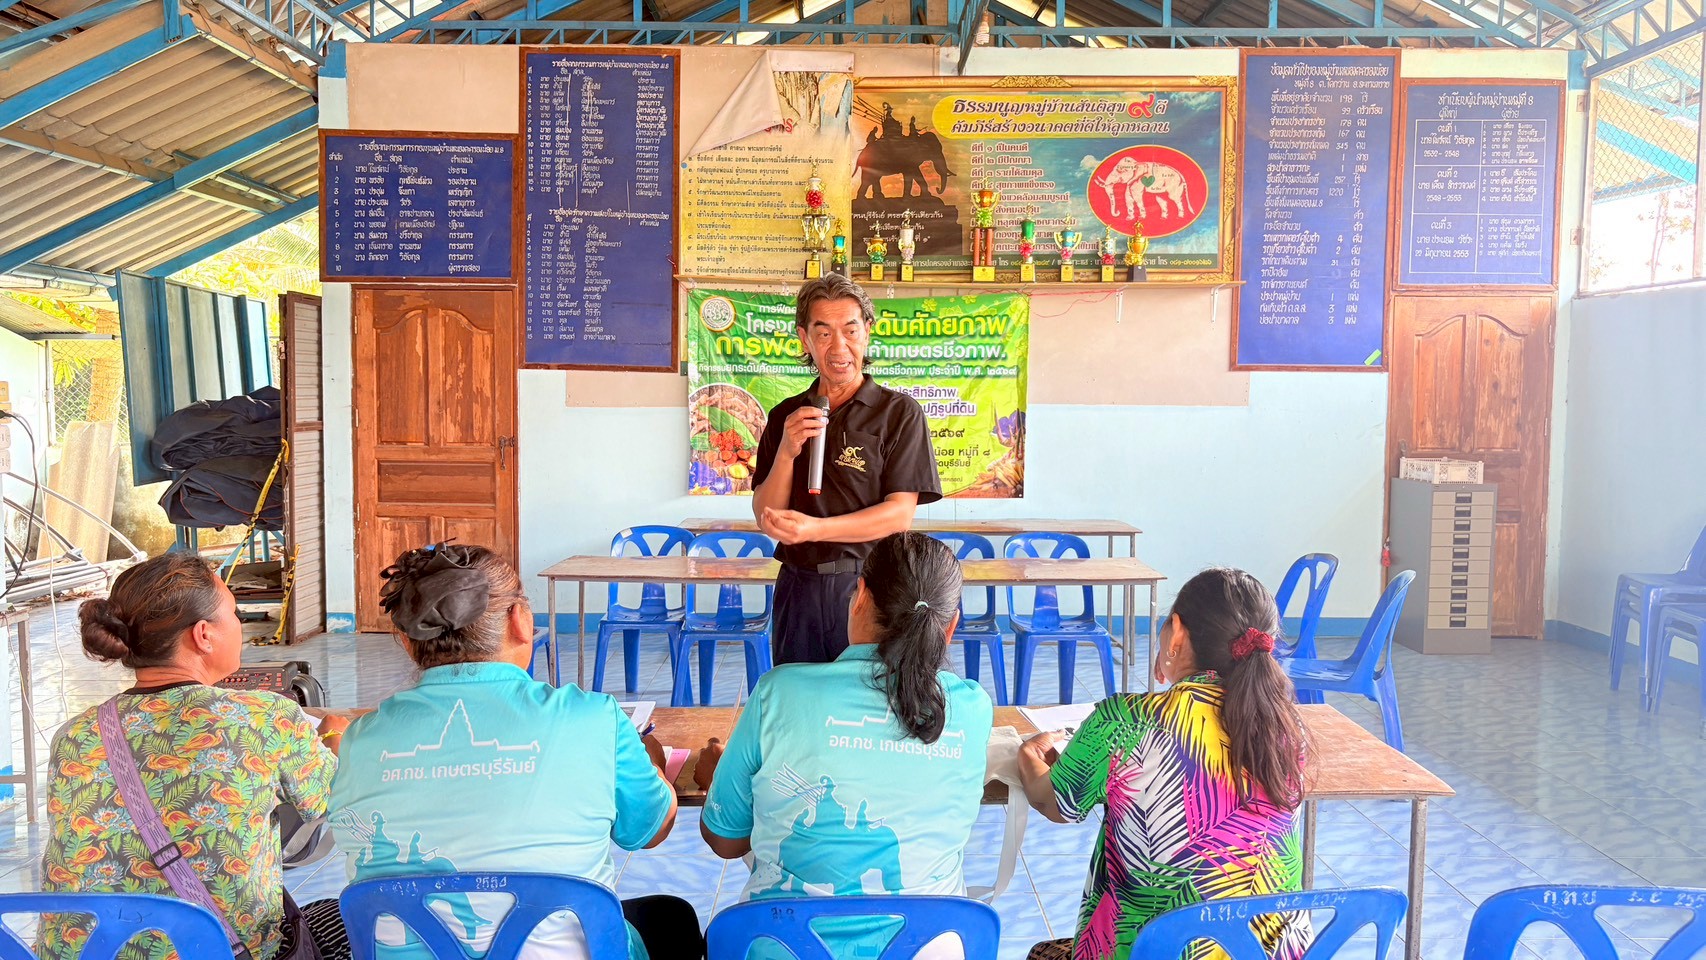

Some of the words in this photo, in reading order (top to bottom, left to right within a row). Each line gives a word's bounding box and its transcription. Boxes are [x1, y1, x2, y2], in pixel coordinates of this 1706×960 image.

[1340, 94, 1352, 102] 198
[1528, 97, 1533, 105] 8
[953, 99, 1126, 116] ธรรมนูญหมู่บ้านสันติสุข
[1128, 94, 1154, 117] ๙
[1155, 100, 1167, 114] ดี
[1357, 104, 1383, 114] ครัวเรือน
[952, 117, 1169, 135] คัมภีร์สร้างอนาคตที่ดีให้ลูกหลาน
[1438, 121, 1452, 132] คนที่
[1356, 130, 1365, 138] คน
[971, 143, 983, 152] ดีที่
[996, 143, 1028, 152] เป็นคนดี
[451, 156, 473, 164] ตำแหน่ง
[971, 155, 983, 164] ดีที่
[998, 156, 1031, 164] มีปัญญา
[971, 168, 983, 177] ดีที่
[996, 168, 1043, 177] รายได้สมดุล
[1355, 164, 1366, 172] แห่ง
[1437, 167, 1452, 177] คนที่
[996, 180, 1054, 189] สุขภาพแข็งแรง
[1329, 188, 1343, 196] 1220
[1354, 210, 1363, 219] ตัว
[1353, 222, 1363, 231] ตัว
[1431, 218, 1447, 229] คนที่
[1338, 235, 1343, 243] 4
[1353, 234, 1362, 243] คัน
[1352, 245, 1360, 254] คัน
[1351, 258, 1359, 266] คัน
[1350, 280, 1359, 289] คัน
[1348, 292, 1359, 300] แห่ง
[1328, 305, 1335, 313] 3
[1346, 304, 1357, 312] แห่ง
[1328, 317, 1334, 325] 3
[1344, 316, 1356, 324] แห่ง
[866, 341, 1006, 358] ค้าเกษตรชีวภาพ.
[929, 365, 960, 376] ประจำปี
[964, 366, 983, 375] พ.ศ.
[920, 399, 975, 416] ปฏิรูปที่ดิน
[959, 445, 978, 458] หมู่ที่
[829, 735, 875, 749] อศ.กช.
[382, 766, 427, 781] อศ.กช.
[432, 756, 536, 780] เกษตรบุรีรัมย์
